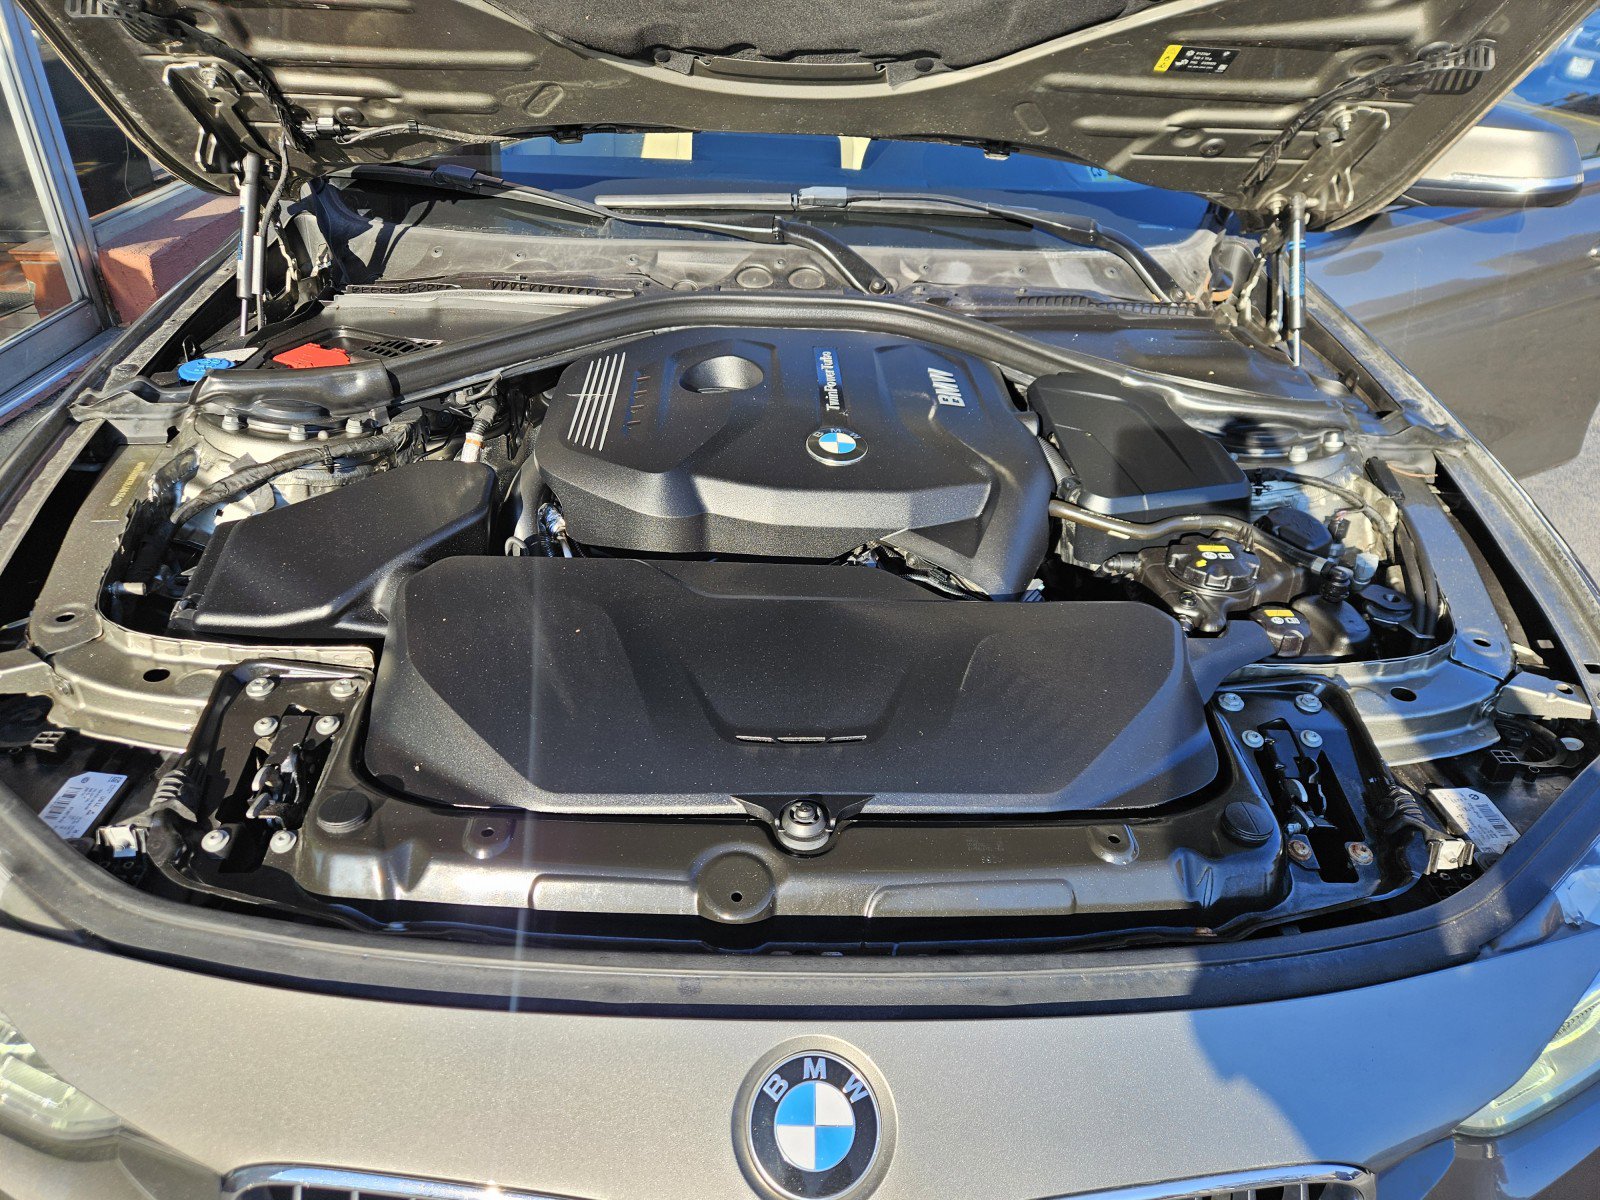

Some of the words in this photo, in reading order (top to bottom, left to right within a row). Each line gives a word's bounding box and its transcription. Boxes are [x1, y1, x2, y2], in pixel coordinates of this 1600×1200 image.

[927, 367, 965, 407] BMW
[813, 428, 861, 439] BMW
[762, 1057, 869, 1103] BMW
